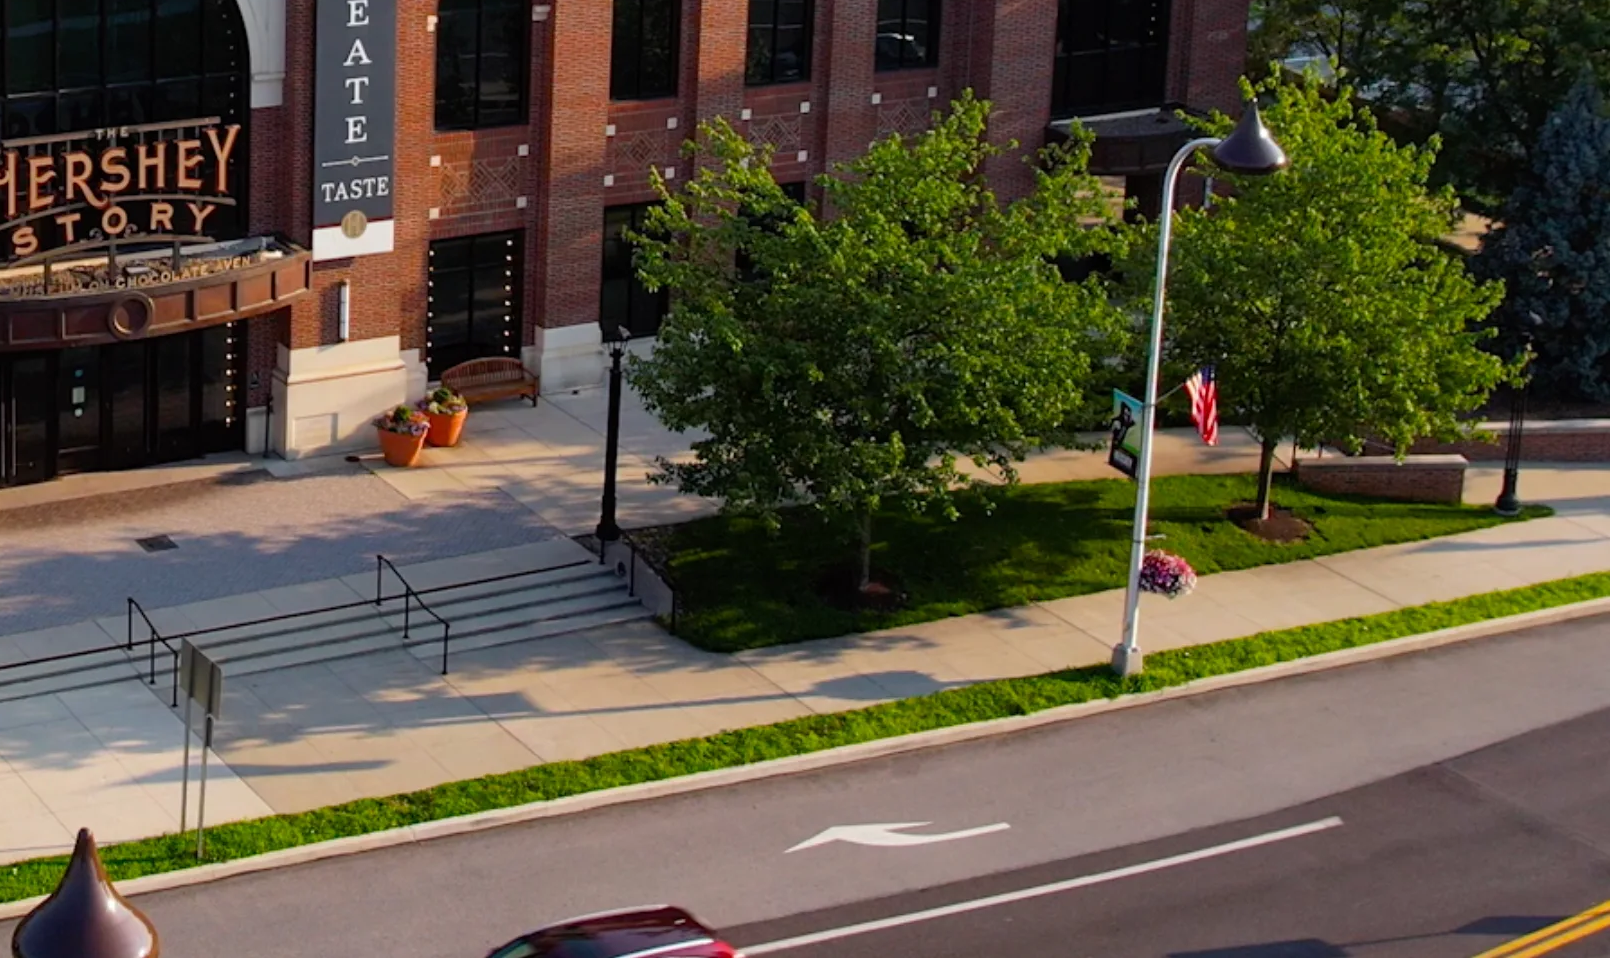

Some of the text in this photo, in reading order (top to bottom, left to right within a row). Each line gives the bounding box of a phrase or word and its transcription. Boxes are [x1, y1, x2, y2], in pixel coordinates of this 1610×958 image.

[95, 126, 130, 142] THE
[321, 176, 389, 203] TASTE
[11, 202, 216, 256] STORY
[116, 263, 210, 288] CHOCOLATE
